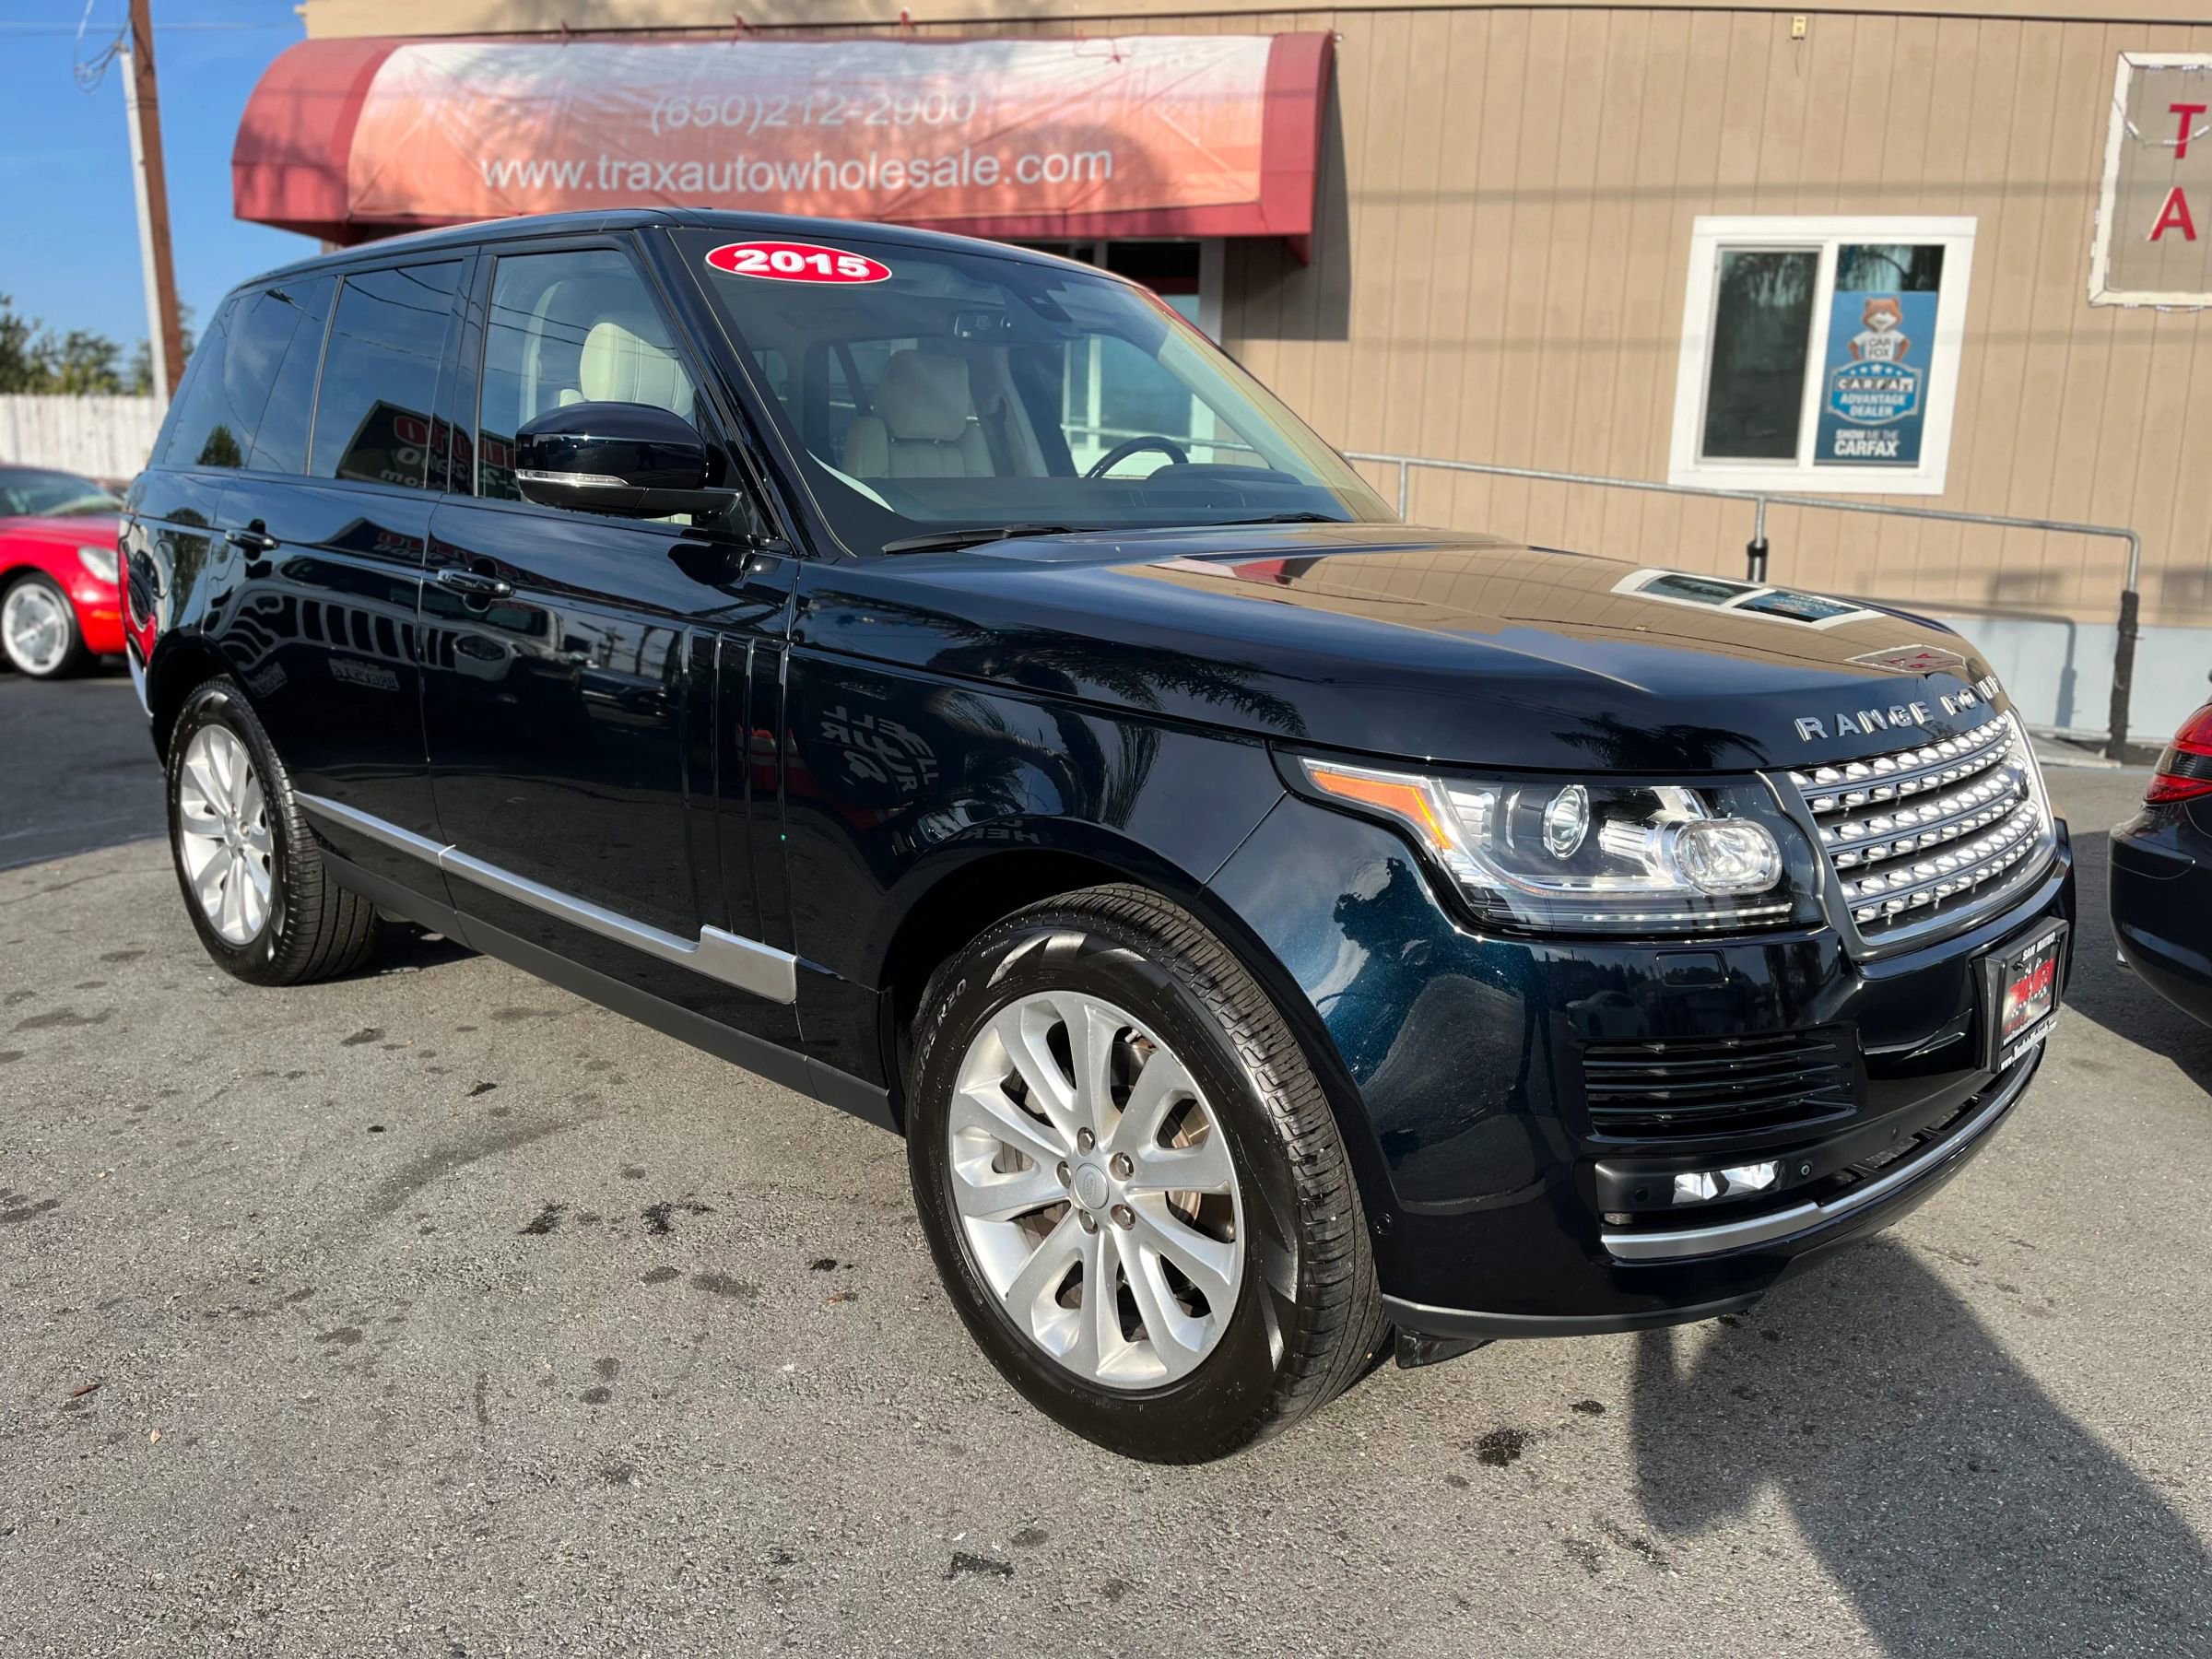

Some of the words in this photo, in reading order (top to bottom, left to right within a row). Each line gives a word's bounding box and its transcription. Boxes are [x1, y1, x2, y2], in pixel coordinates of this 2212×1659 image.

[650, 93, 977, 136] (650)212-2900
[480, 147, 1112, 192] www.traxautowholesale.com
[734, 249, 870, 278] 2015
[1838, 378, 1913, 392] CARFAX
[1840, 394, 1906, 406] ADVANTAGE
[1850, 406, 1893, 417] DEALER
[1835, 429, 1865, 440] SHOW
[1834, 441, 1899, 457] CARFAX
[1794, 700, 1936, 743] RANGE
